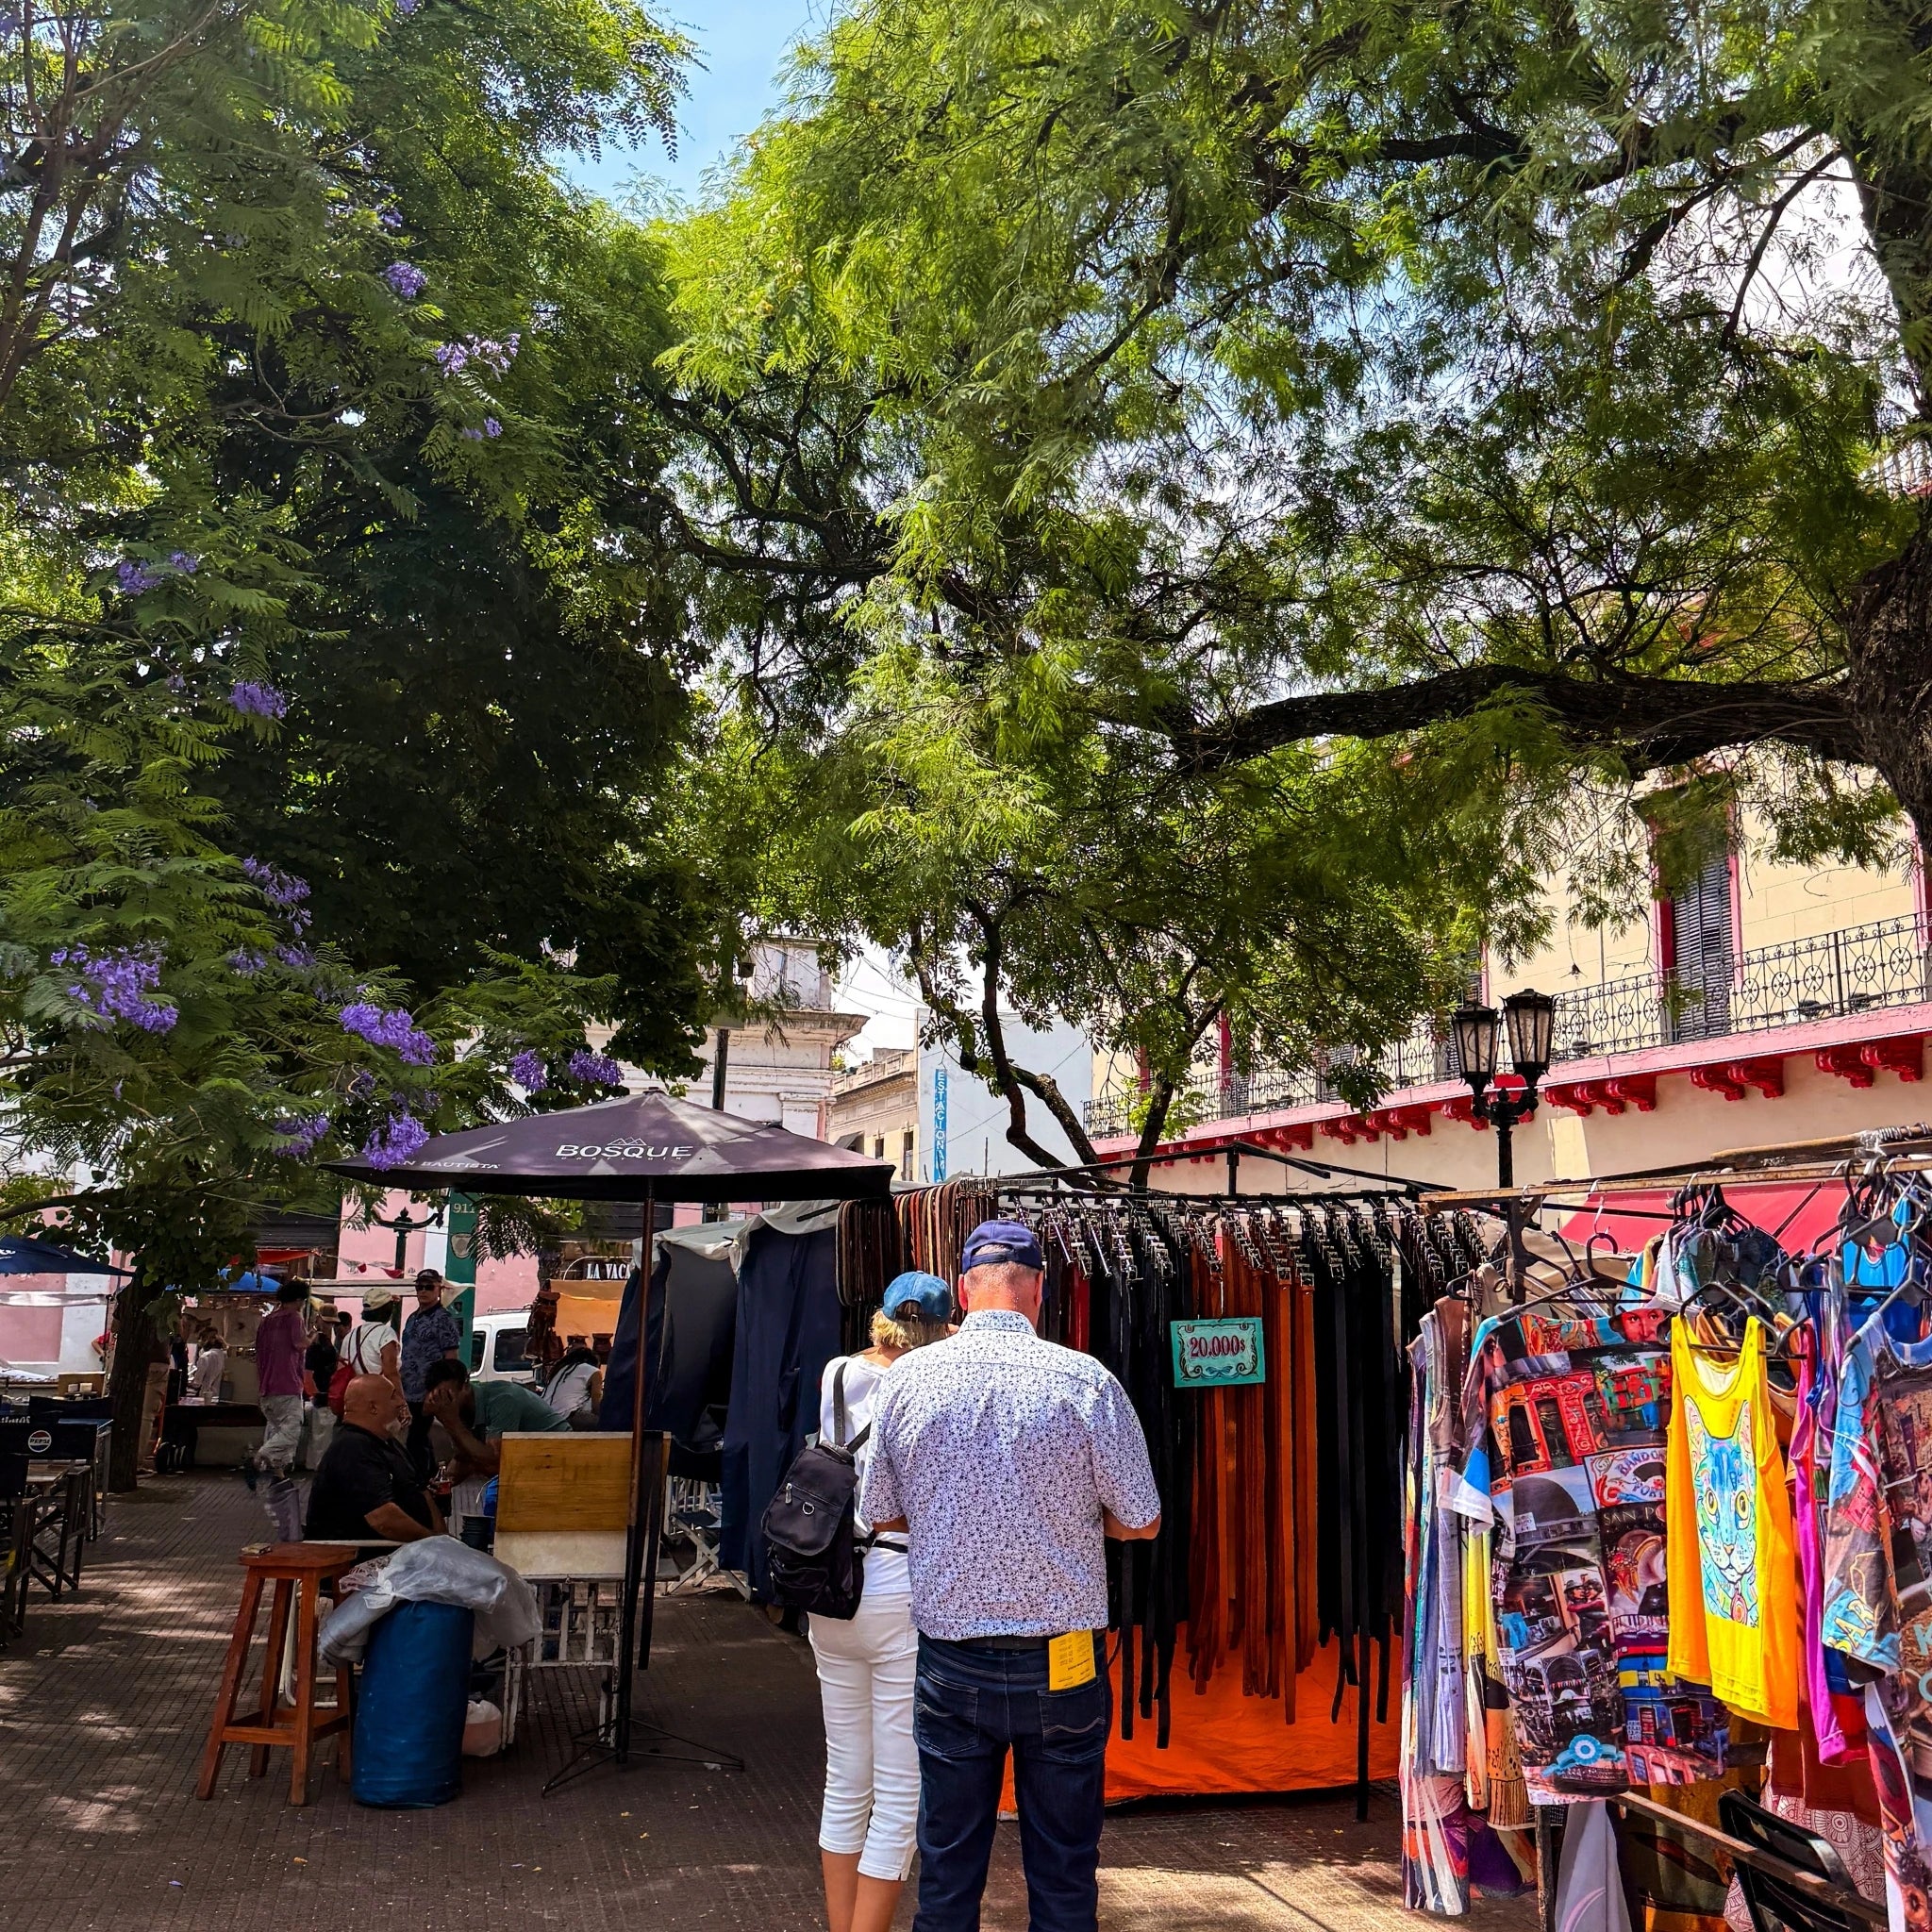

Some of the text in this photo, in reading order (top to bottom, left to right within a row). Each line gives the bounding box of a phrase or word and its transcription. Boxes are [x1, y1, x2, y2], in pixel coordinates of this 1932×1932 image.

[555, 1144, 693, 1158] BOSQUE
[587, 1263, 601, 1279] LA
[1603, 1510, 1636, 1525] SAN
